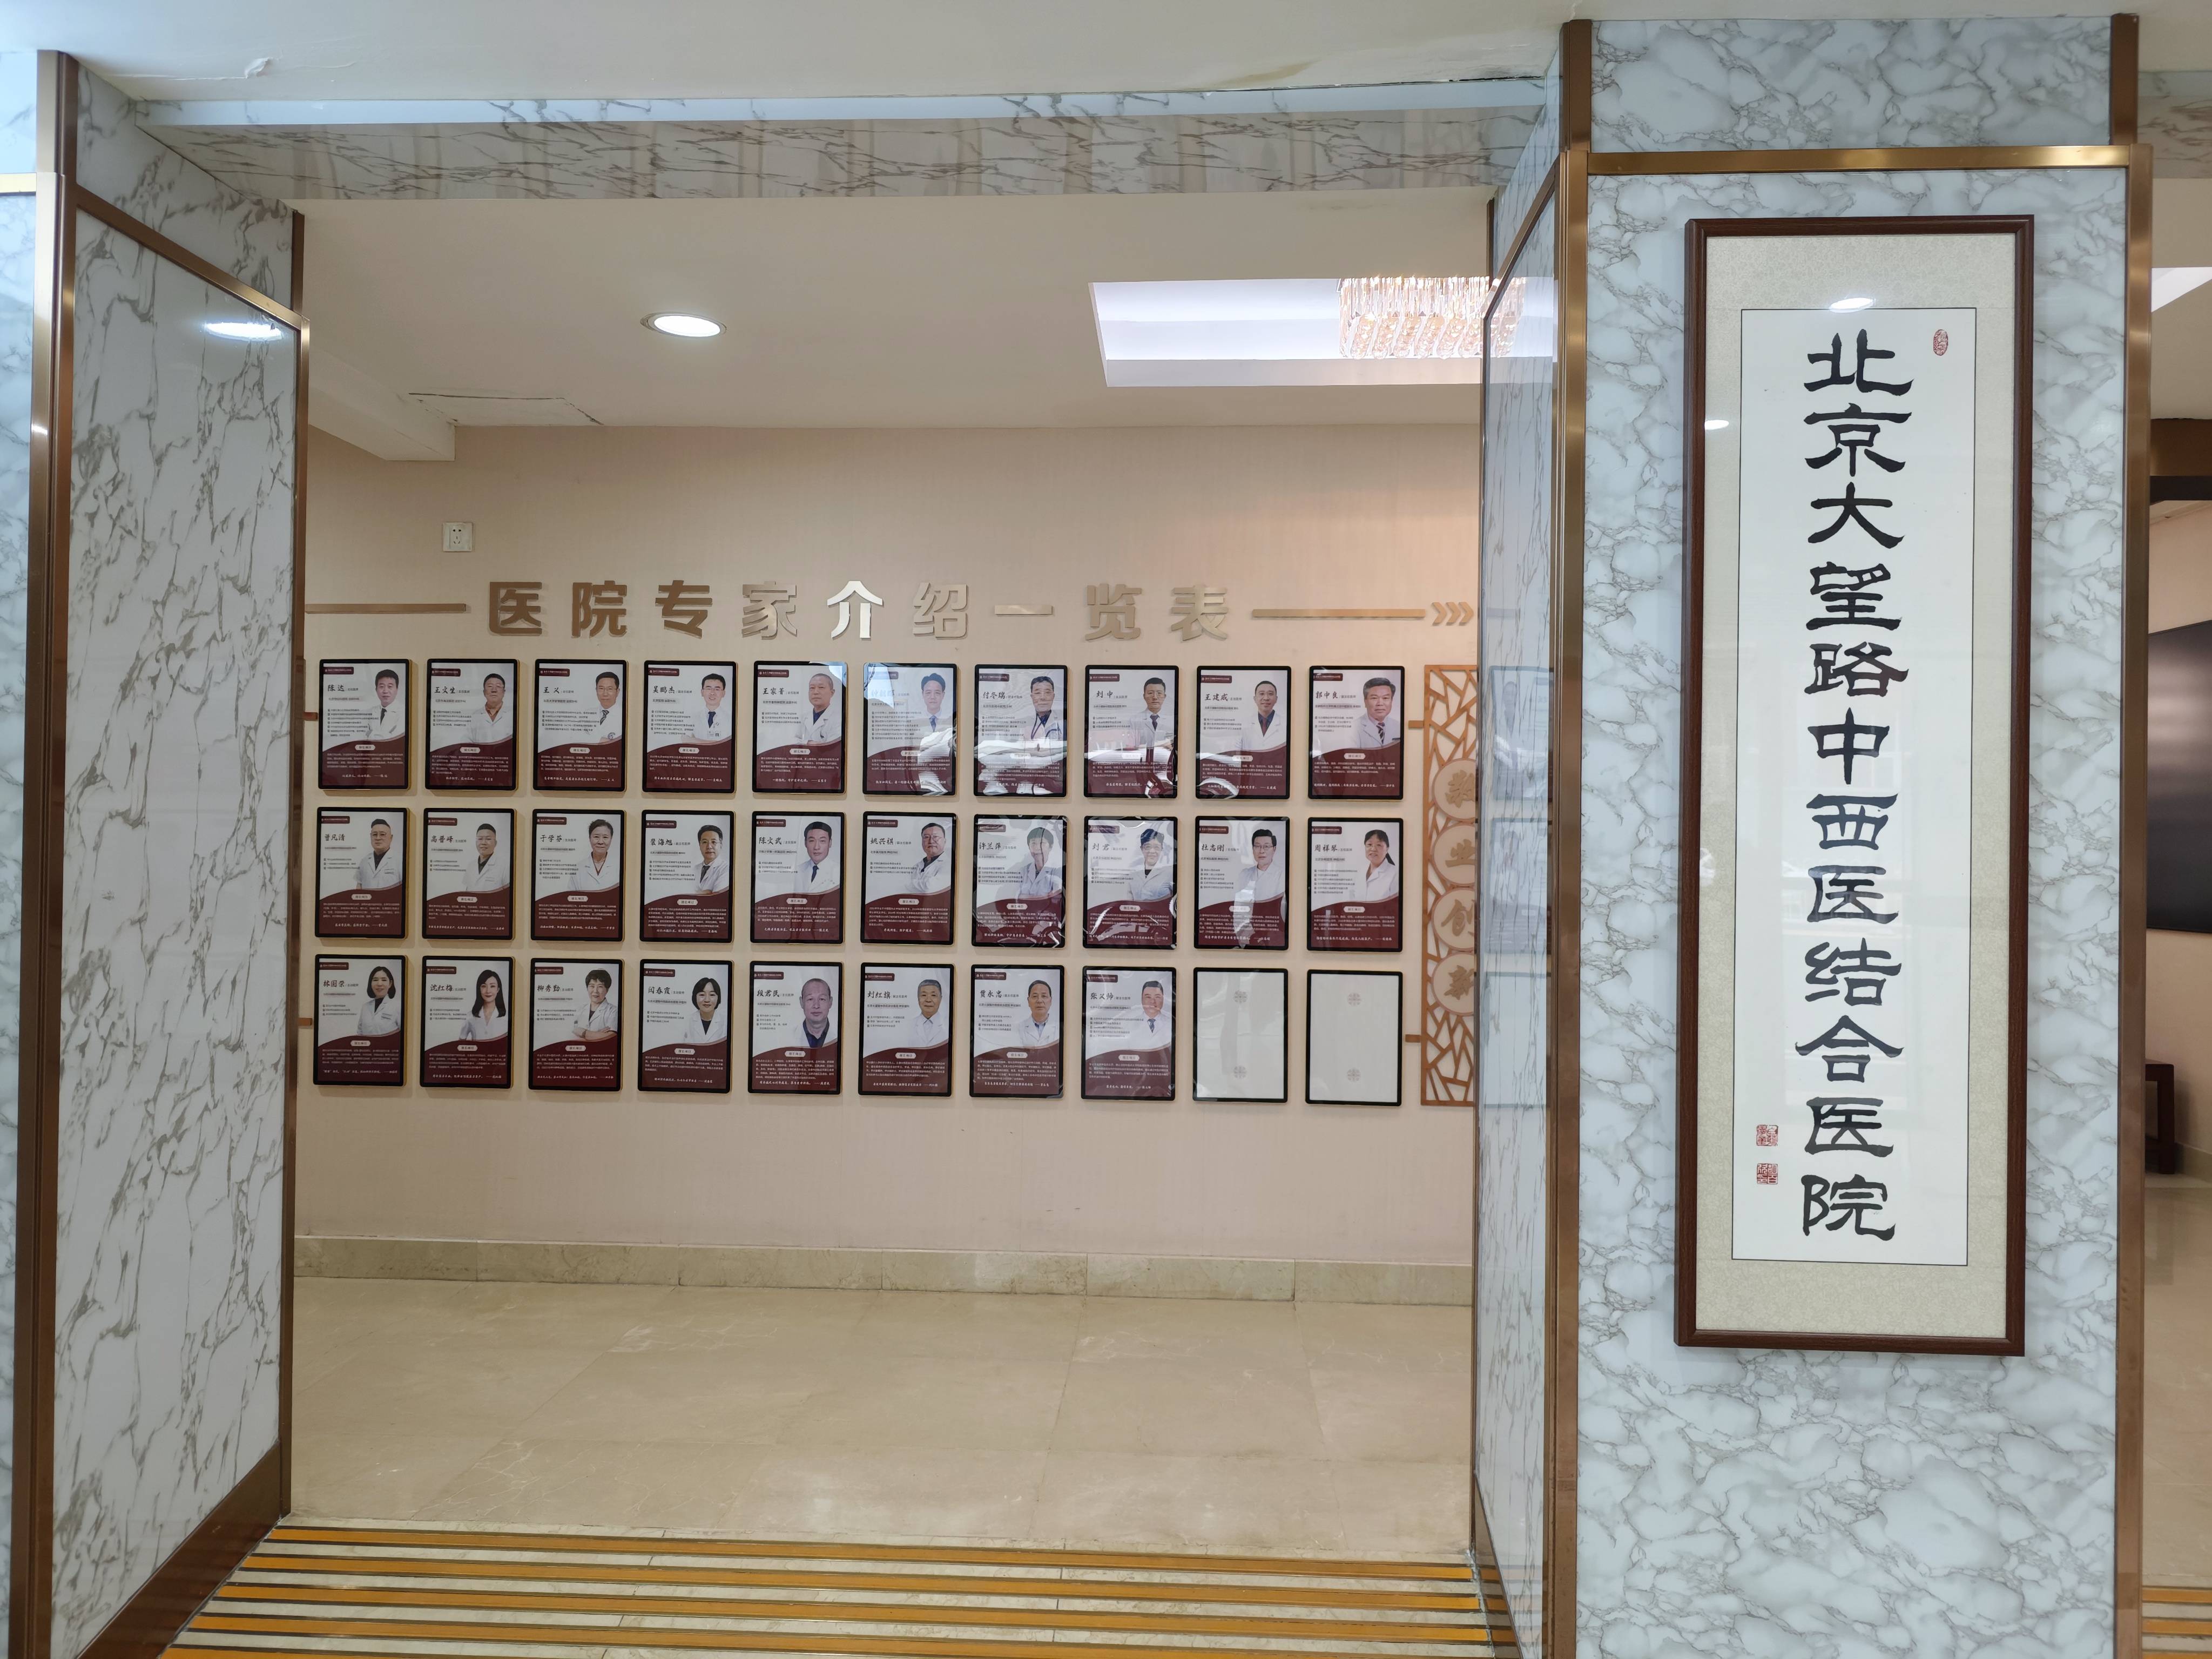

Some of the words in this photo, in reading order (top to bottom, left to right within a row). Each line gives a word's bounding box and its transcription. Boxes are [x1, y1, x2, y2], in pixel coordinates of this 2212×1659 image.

[488, 580, 1229, 642] 医院专家介绍一览表
[1795, 329, 1914, 1241] 北京大望路中西医结合医院
